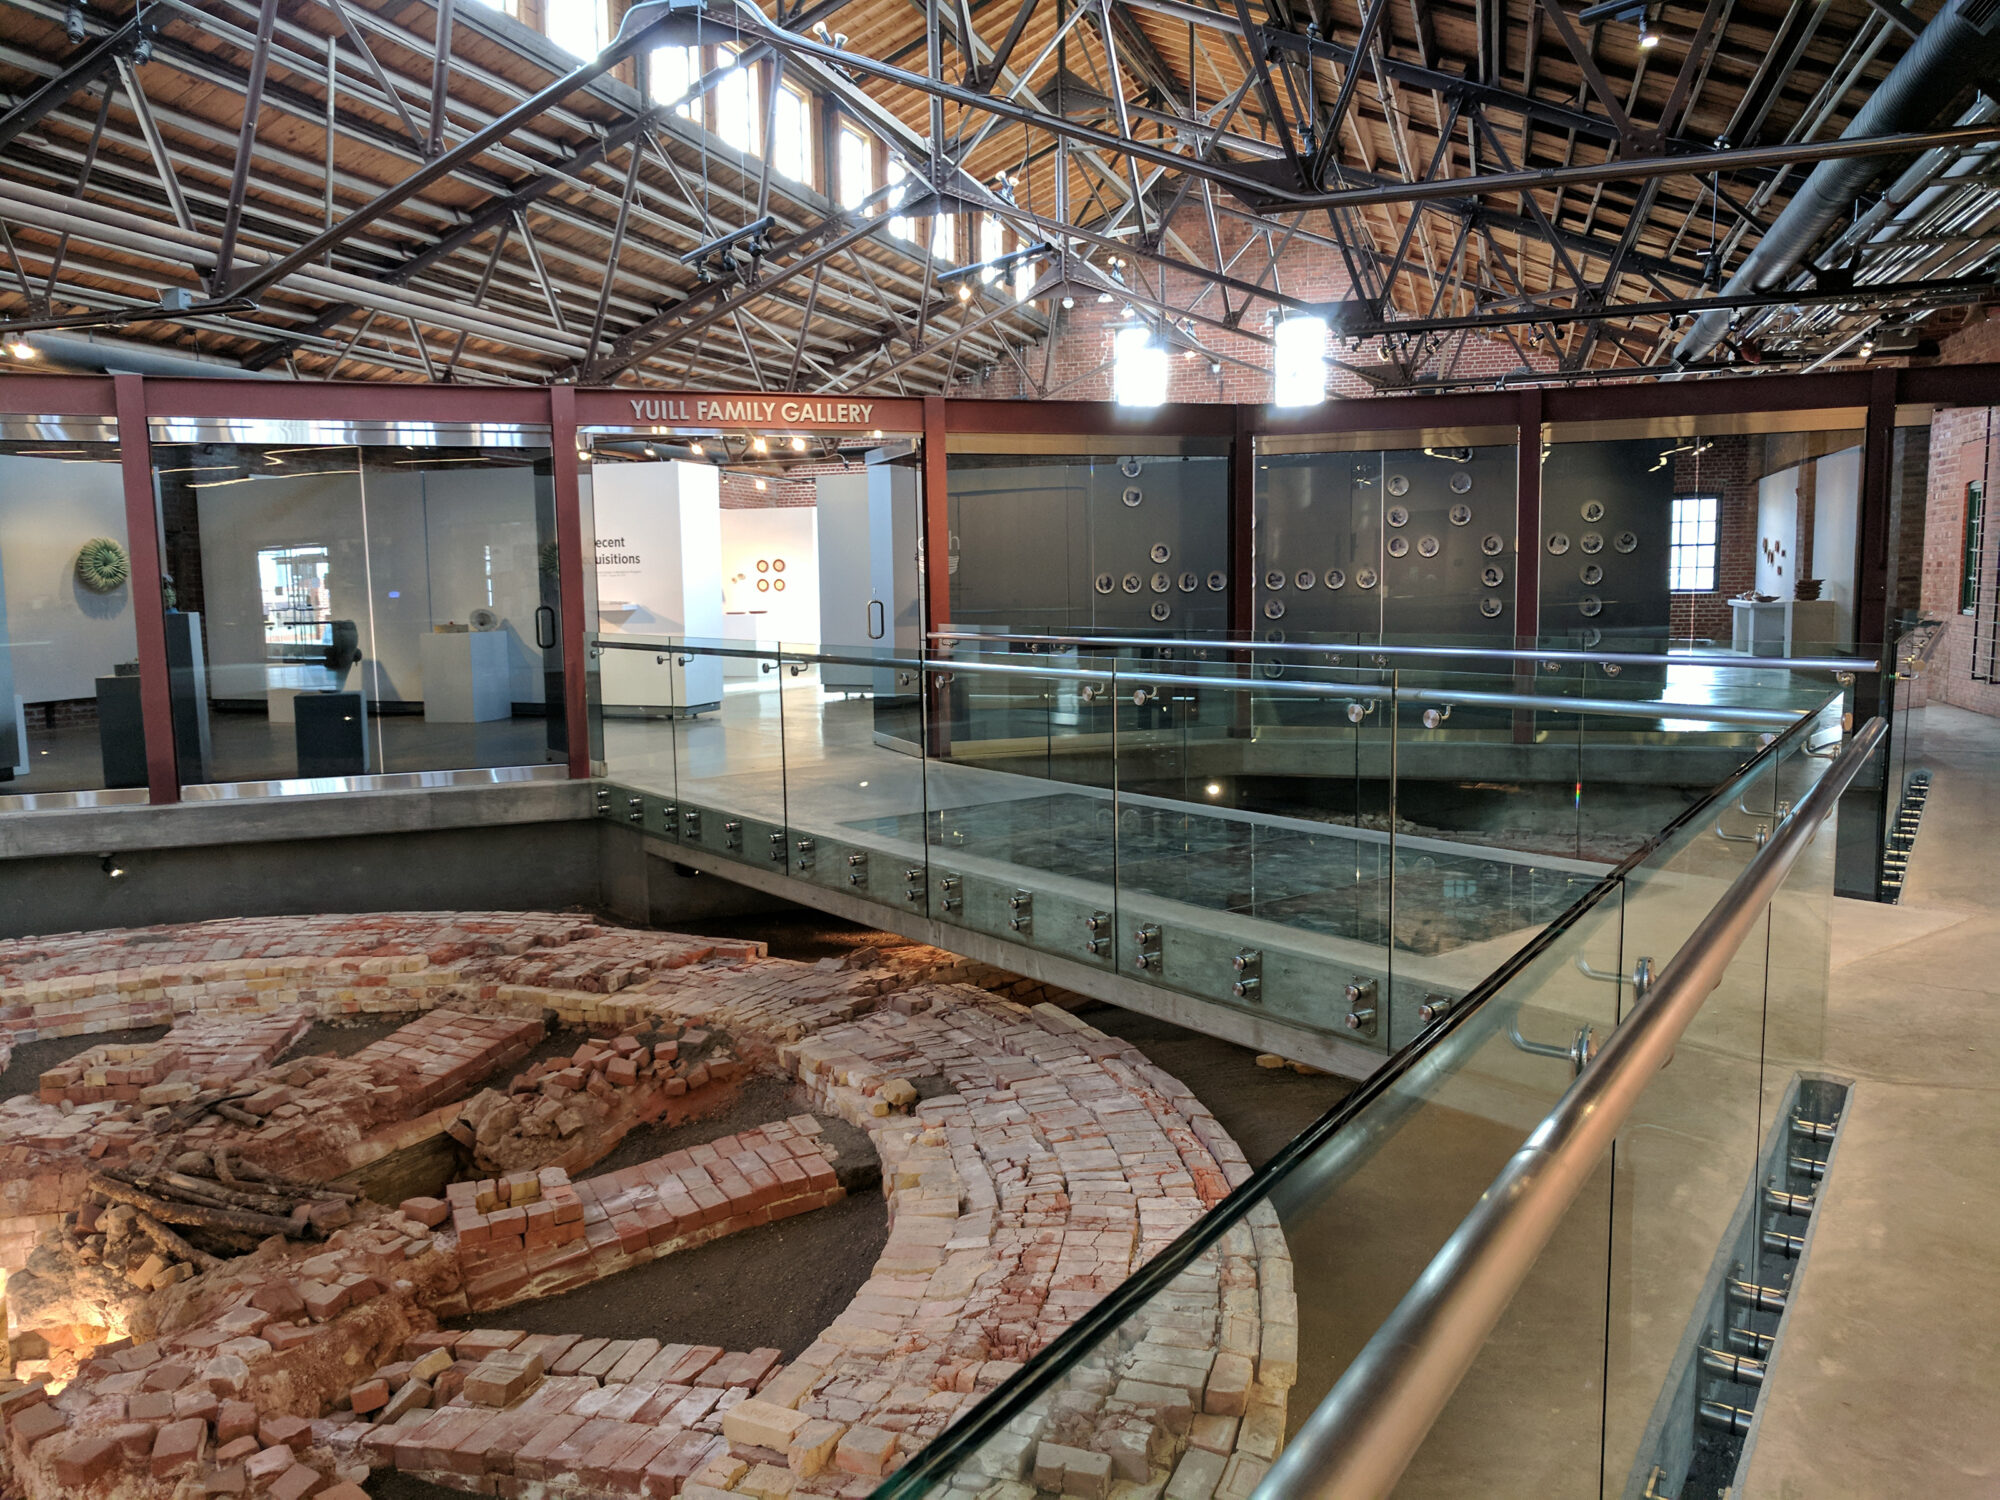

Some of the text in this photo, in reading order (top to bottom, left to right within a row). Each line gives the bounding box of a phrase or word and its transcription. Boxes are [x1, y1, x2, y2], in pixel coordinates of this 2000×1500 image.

[630, 399, 873, 424] YUILL FAMILY GALLERY
[595, 537, 625, 548] ecent
[594, 553, 641, 565] uisitions
